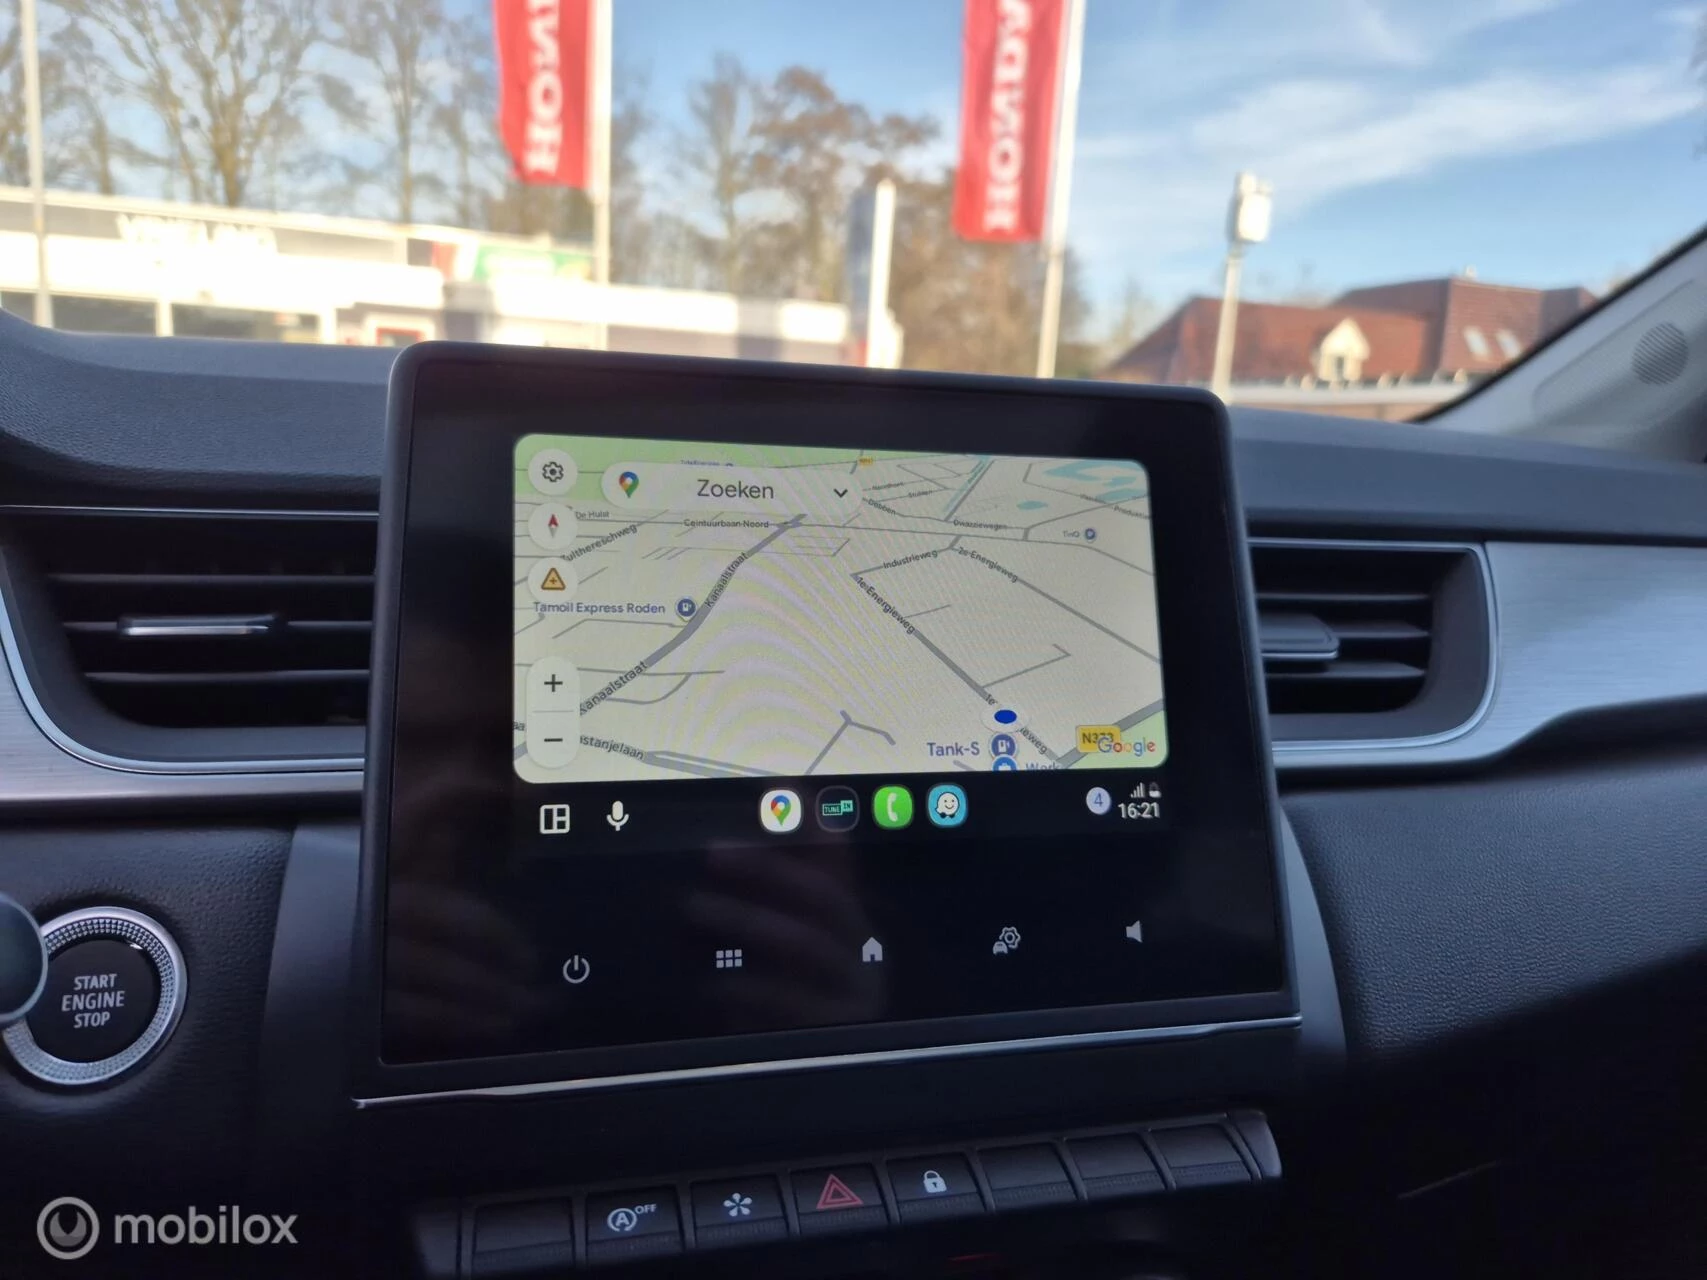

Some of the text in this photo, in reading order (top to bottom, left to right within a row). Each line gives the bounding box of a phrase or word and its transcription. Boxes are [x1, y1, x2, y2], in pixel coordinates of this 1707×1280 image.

[697, 479, 774, 499] Zoeken
[743, 520, 769, 528] Noord
[883, 550, 938, 569] Industrieweg
[970, 550, 1019, 583] Energieweg
[704, 552, 748, 609] Kanaalstraat
[534, 602, 666, 615] Tamoil Express Roden
[867, 585, 916, 635] Energieweg
[927, 741, 980, 757] Tank-S
[1098, 737, 1156, 757] Google
[1093, 792, 1104, 807] 4
[1118, 802, 1160, 819] 16:21
[73, 974, 118, 991] START
[61, 991, 126, 1012] ENGINE
[73, 1012, 111, 1029] STOP
[634, 1203, 657, 1215] OFF
